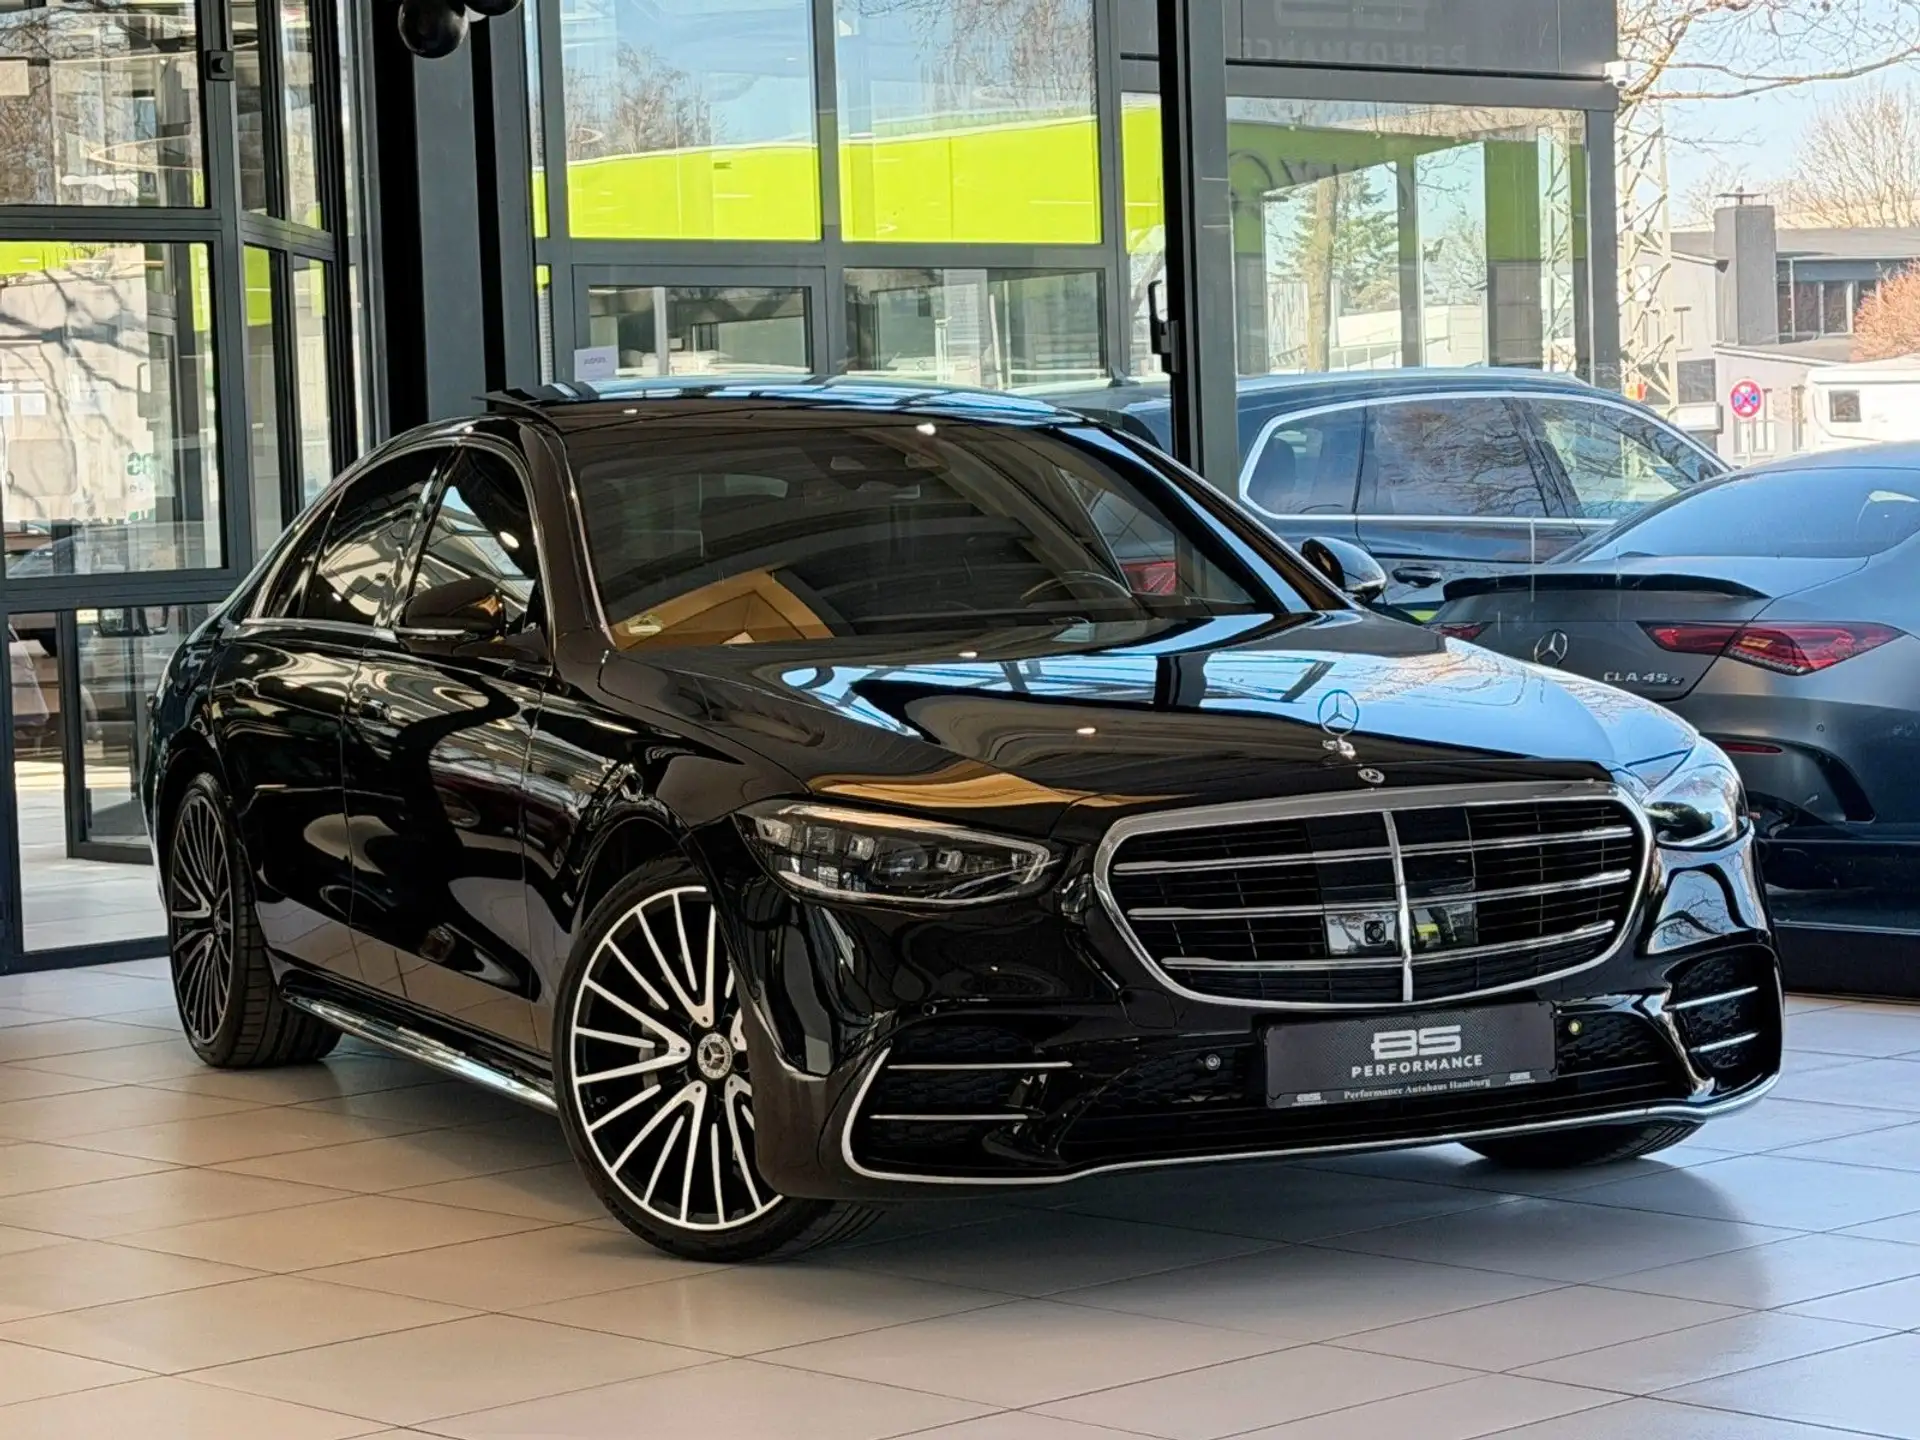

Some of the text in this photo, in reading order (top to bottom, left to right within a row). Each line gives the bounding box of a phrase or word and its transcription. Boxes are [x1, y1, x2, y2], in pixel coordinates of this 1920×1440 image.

[1603, 671, 1639, 682] CLA
[1642, 672, 1668, 683] 45
[1351, 1054, 1483, 1078] PERFORMANCE
[1343, 1088, 1402, 1099] Performance
[1405, 1083, 1447, 1093] Autohaus
[1449, 1078, 1491, 1090] Hamburg
